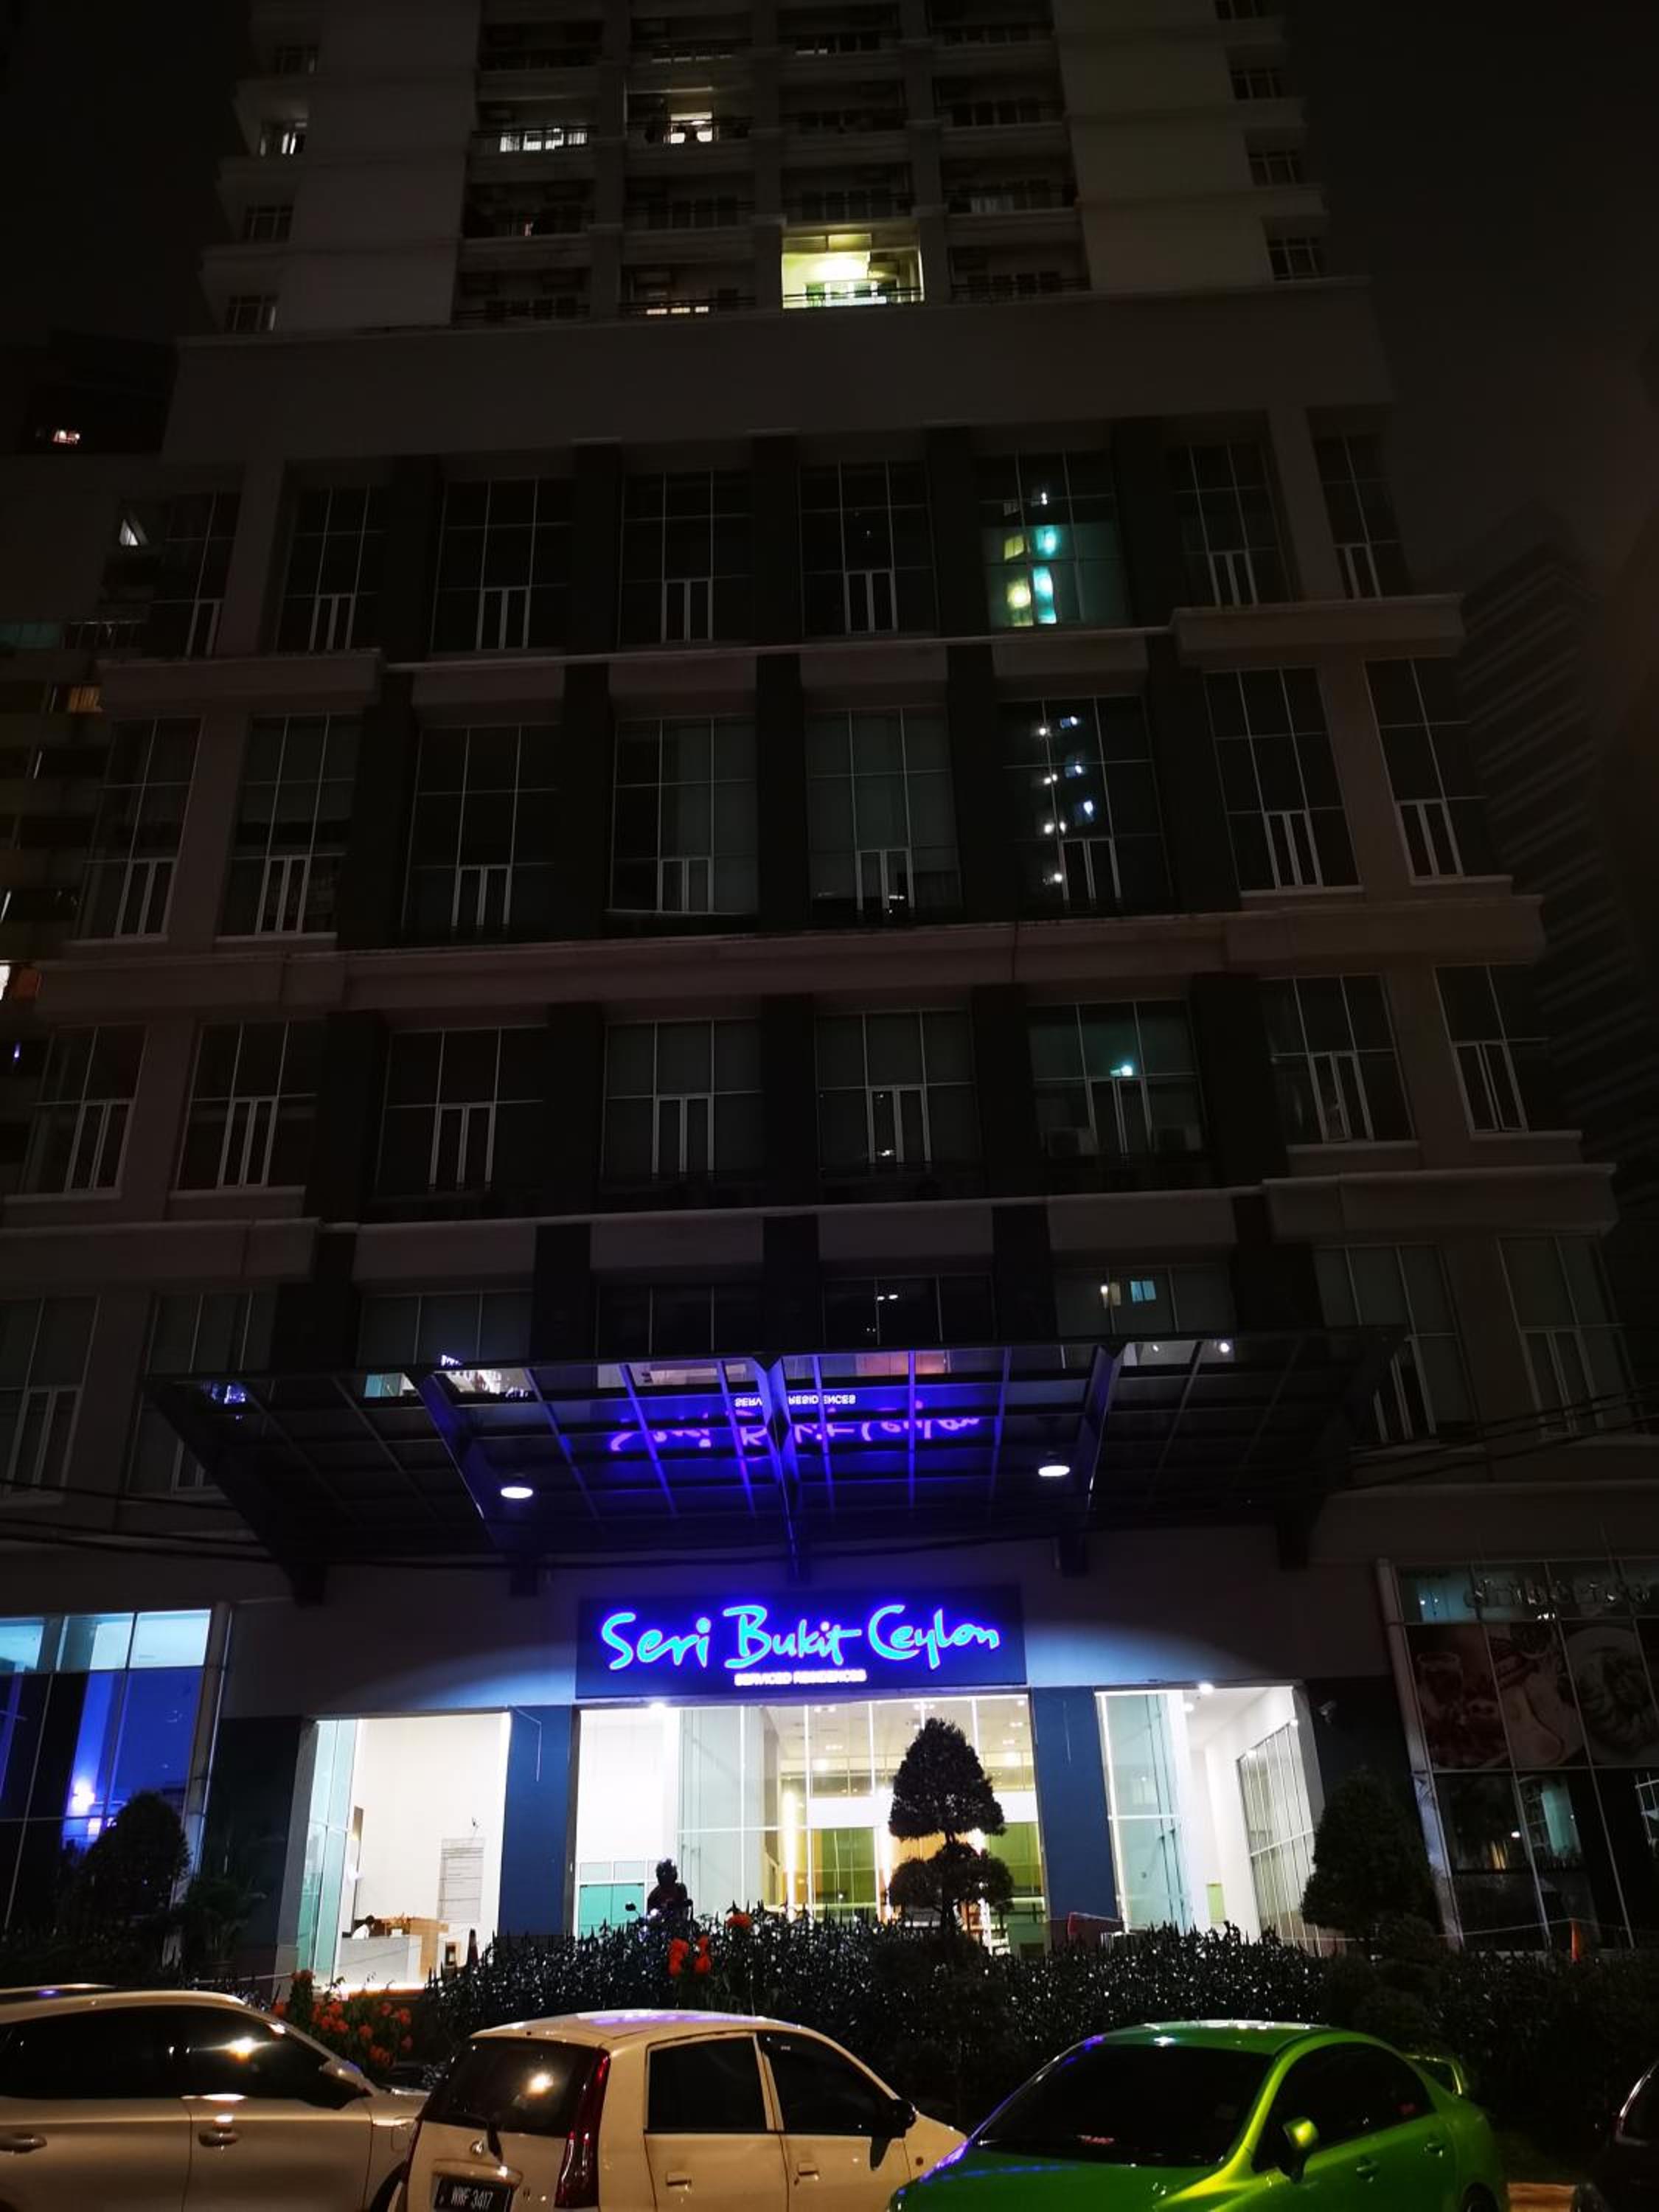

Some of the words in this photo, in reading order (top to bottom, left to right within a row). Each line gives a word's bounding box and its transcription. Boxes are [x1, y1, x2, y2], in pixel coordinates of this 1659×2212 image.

[601, 1612, 712, 1670] Seri
[723, 1604, 862, 1669] Bukit
[868, 1604, 1000, 1669] Ceylon
